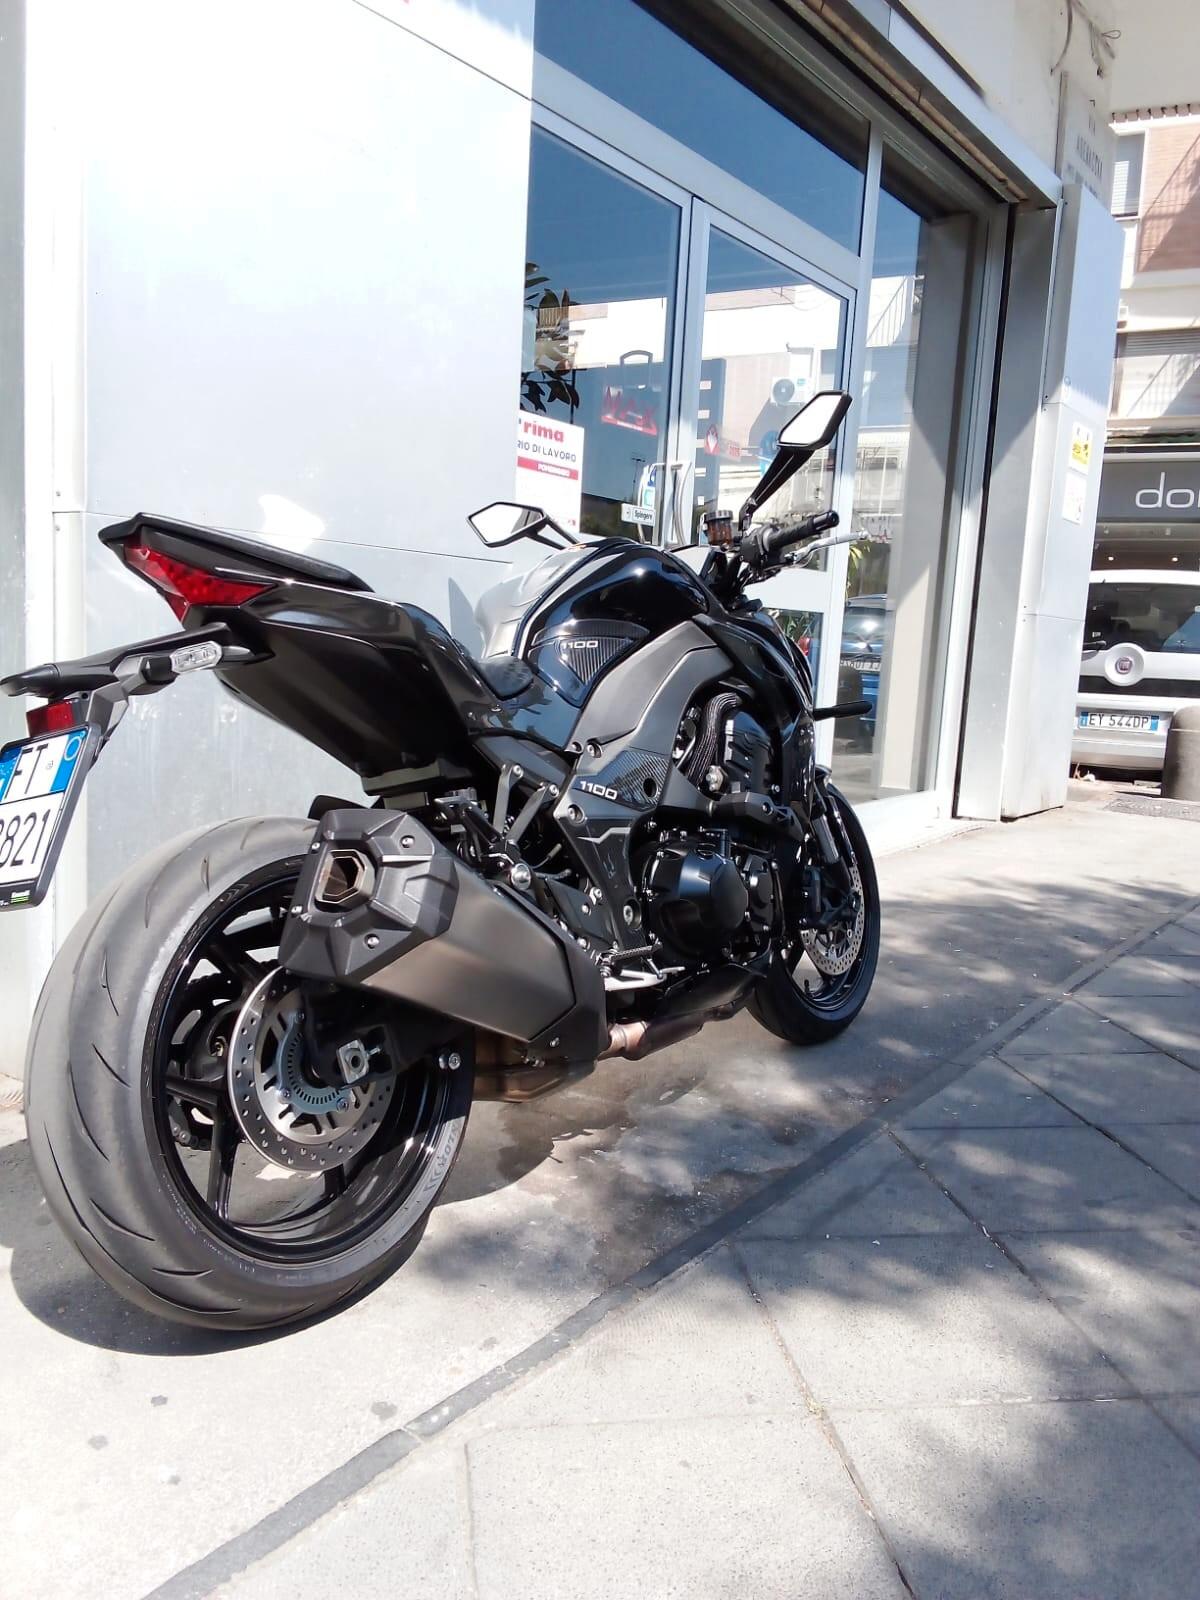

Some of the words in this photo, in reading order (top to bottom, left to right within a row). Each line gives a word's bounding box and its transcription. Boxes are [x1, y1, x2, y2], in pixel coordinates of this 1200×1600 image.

[543, 446, 577, 463] LAVORO
[1135, 472, 1200, 508] do
[1089, 713, 1105, 726] EY
[1109, 715, 1149, 729] 544DP
[4, 743, 49, 799] FT
[580, 780, 618, 800] 1100
